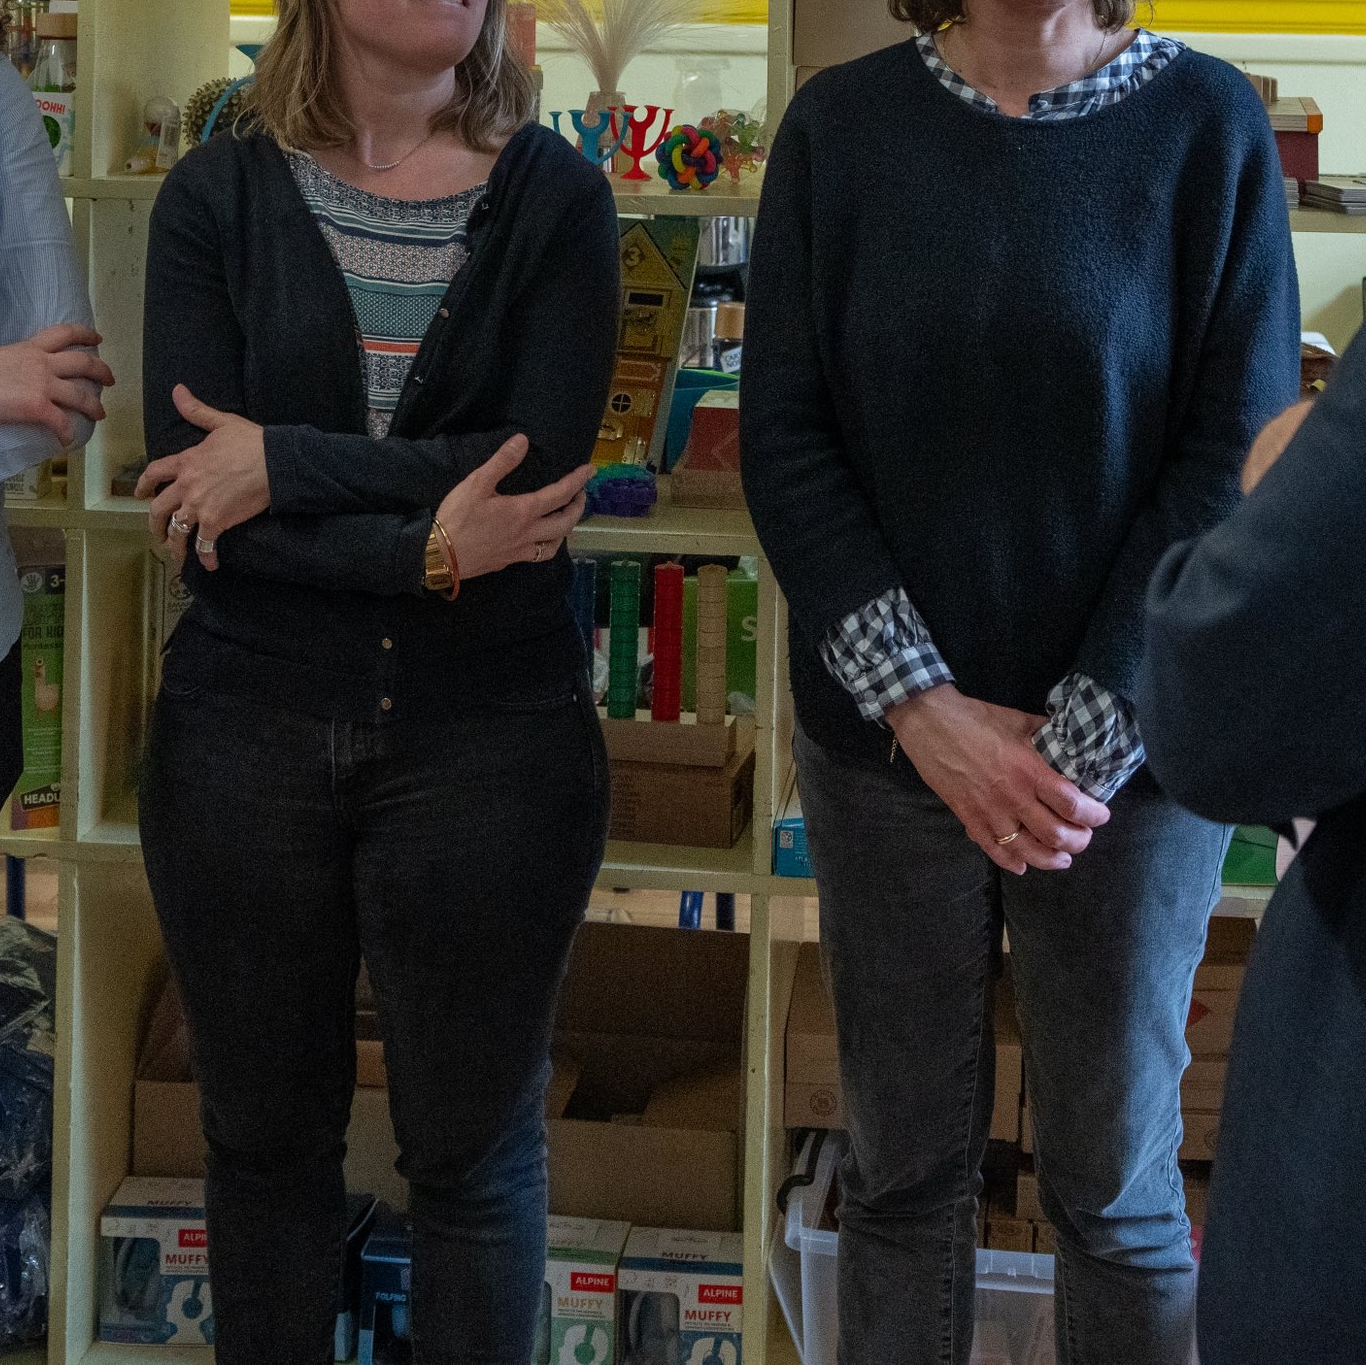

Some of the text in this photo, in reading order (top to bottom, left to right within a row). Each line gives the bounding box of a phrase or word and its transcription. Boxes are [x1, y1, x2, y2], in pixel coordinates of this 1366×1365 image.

[661, 1251, 707, 1260] MUFFY
[575, 1276, 610, 1286] ALPINE
[703, 1288, 738, 1299] ALPINE
[557, 1296, 603, 1310] MUFFY
[684, 1310, 731, 1322] MUFFY
